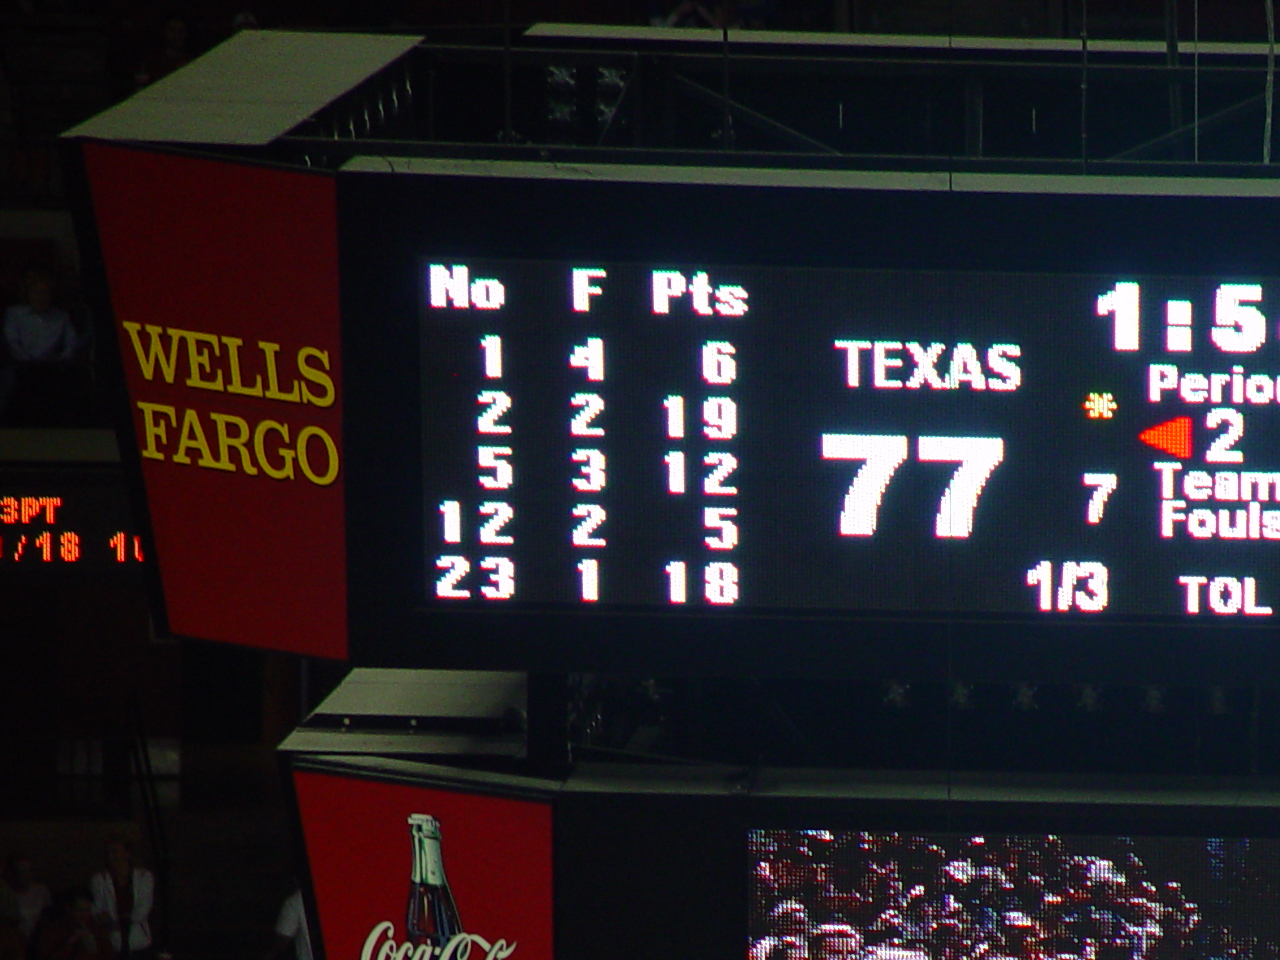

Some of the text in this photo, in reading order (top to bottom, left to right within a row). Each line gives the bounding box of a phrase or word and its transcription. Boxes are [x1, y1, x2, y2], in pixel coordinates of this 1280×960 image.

[430, 264, 748, 315] No F Pts
[122, 320, 336, 407] WELLS
[480, 335, 736, 384] 1 4 6
[835, 340, 1022, 391] TEXAS
[477, 390, 737, 439] 2 2 19
[1206, 408, 1243, 462] 2
[136, 401, 340, 486] FARGO
[478, 446, 737, 494] 5 3 12
[822, 433, 1003, 537] 77
[0, 496, 62, 524] 3PT
[1084, 473, 1117, 523] 7
[0, 531, 80, 562] /18
[439, 500, 738, 549] 12 2 5
[436, 555, 738, 603] 23 1 18
[1027, 560, 1108, 610] 1/3
[1179, 576, 1272, 614] TOL
